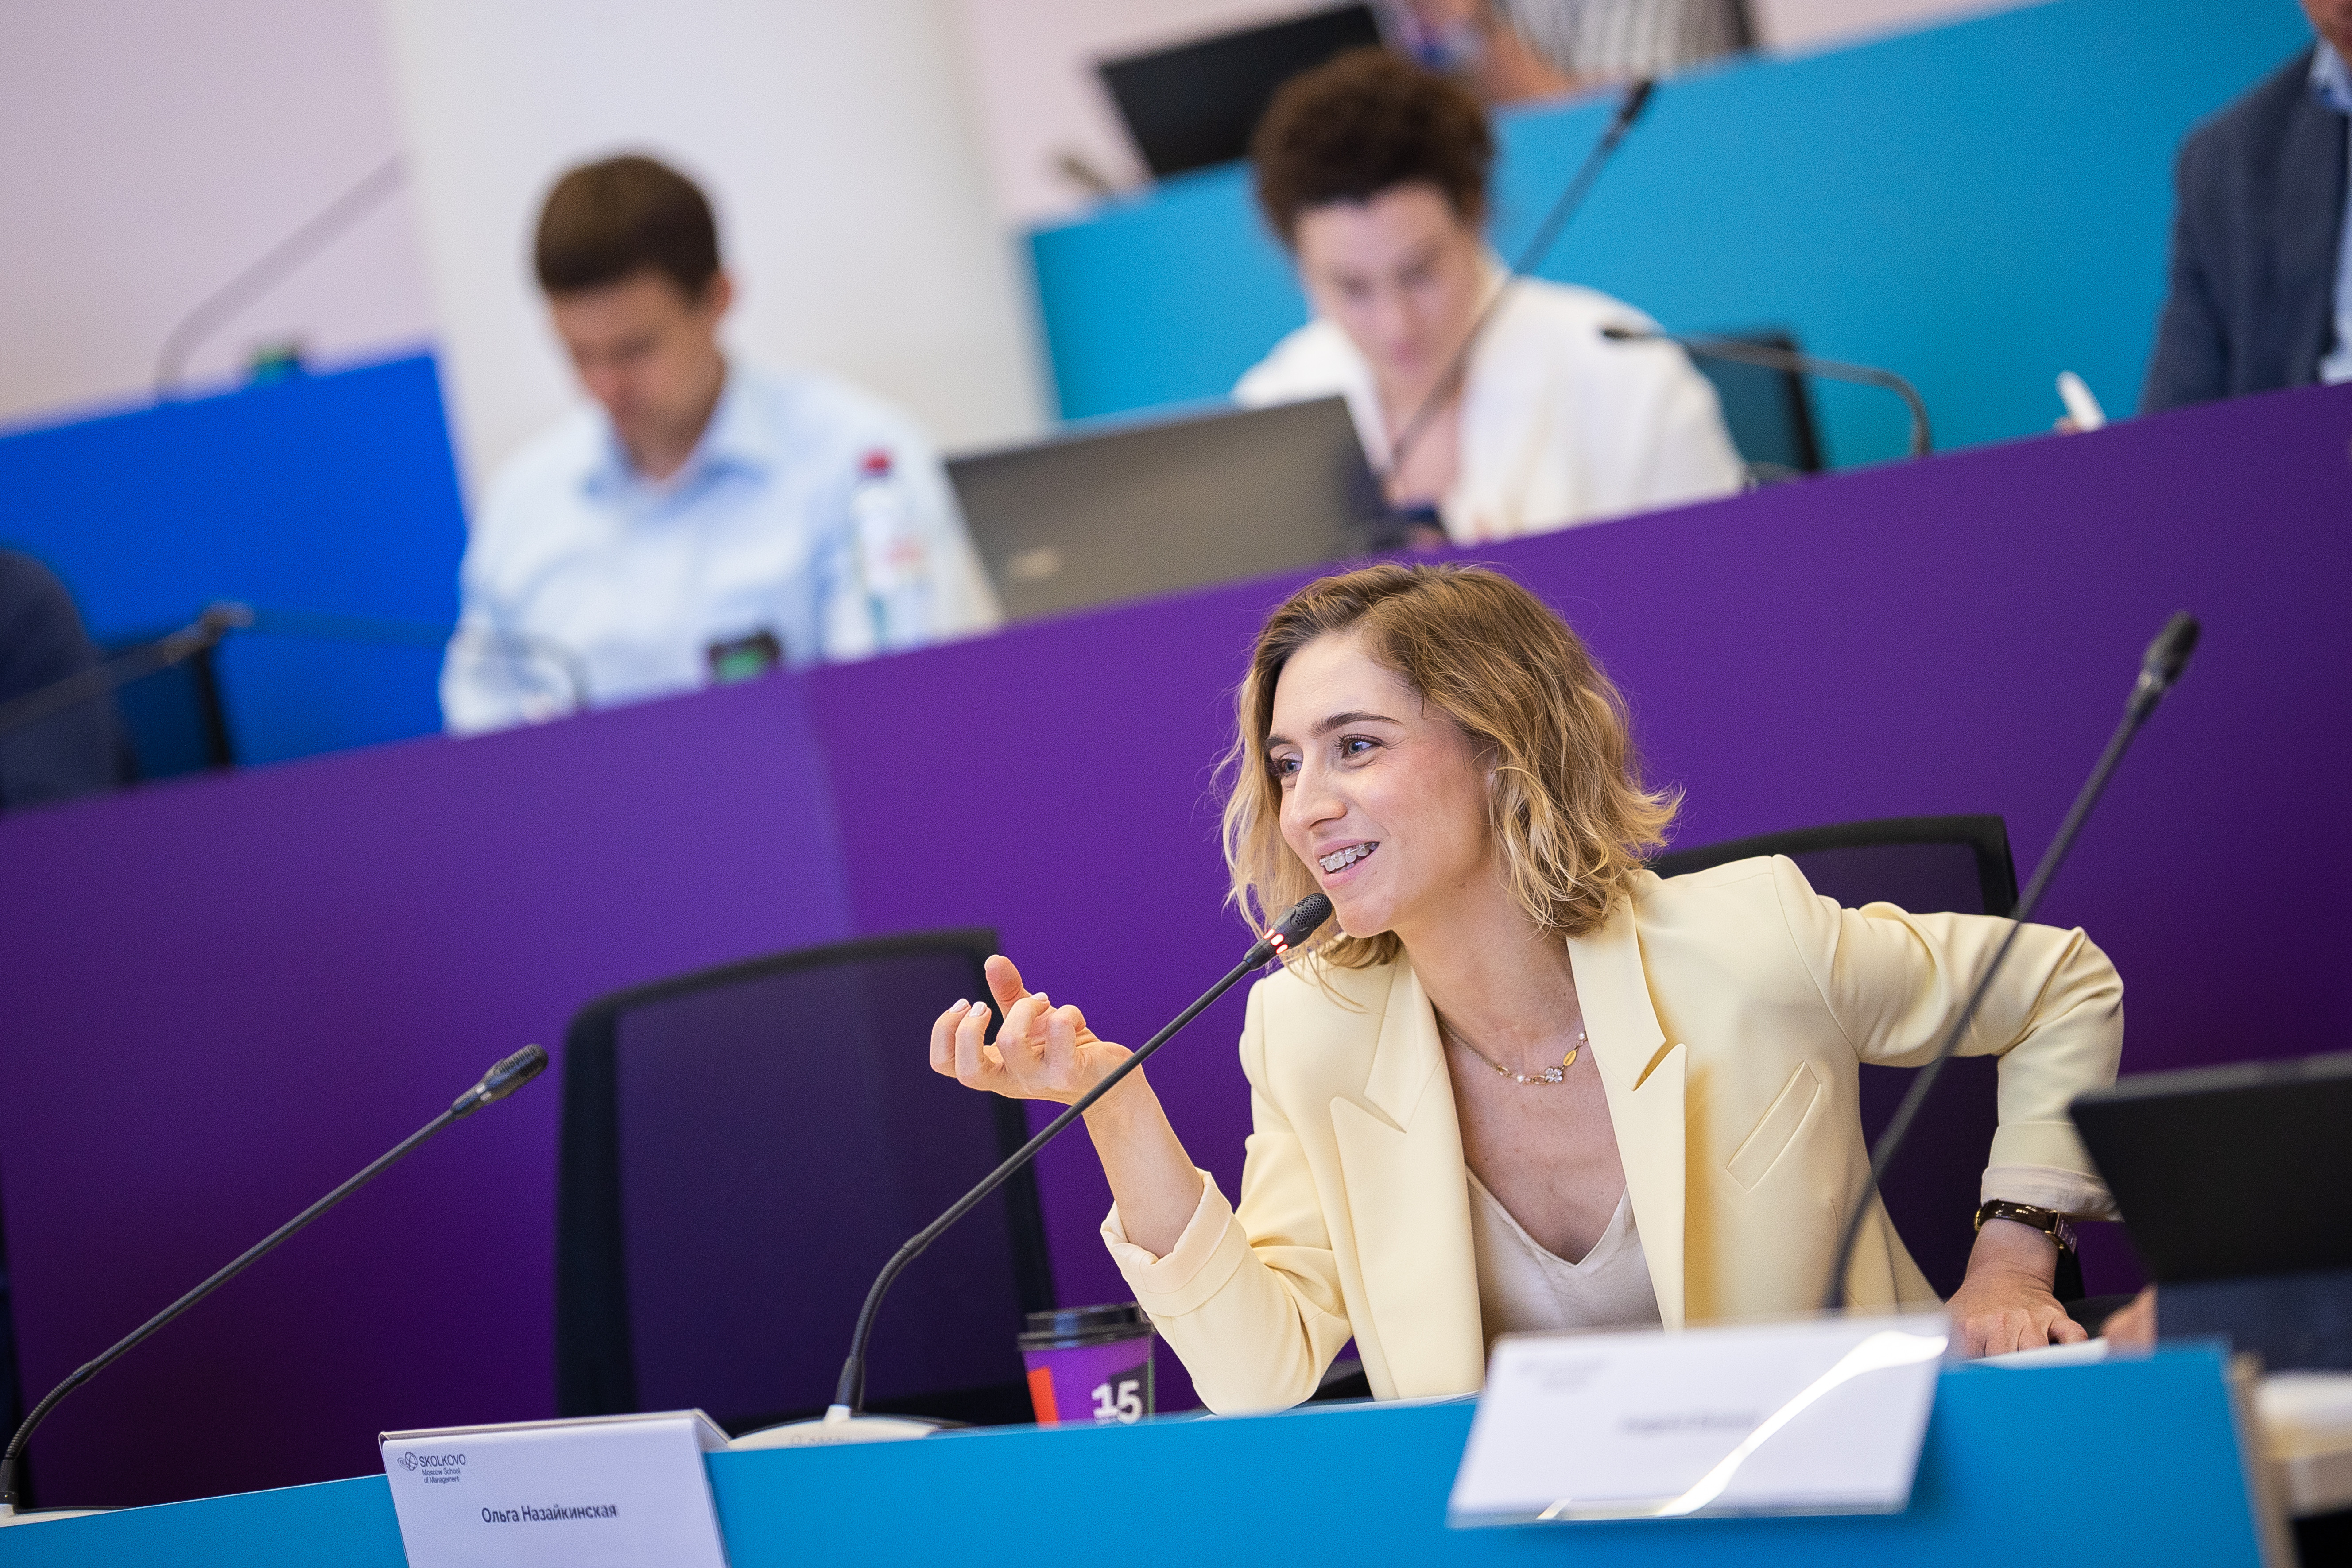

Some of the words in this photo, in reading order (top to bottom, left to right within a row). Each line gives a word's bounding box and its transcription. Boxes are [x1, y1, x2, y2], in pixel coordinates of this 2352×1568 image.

[1092, 1379, 1143, 1424] 15
[419, 1454, 465, 1467] SKOLKOVO
[481, 1506, 519, 1523] Ольга
[520, 1503, 617, 1522] Назайкинская
